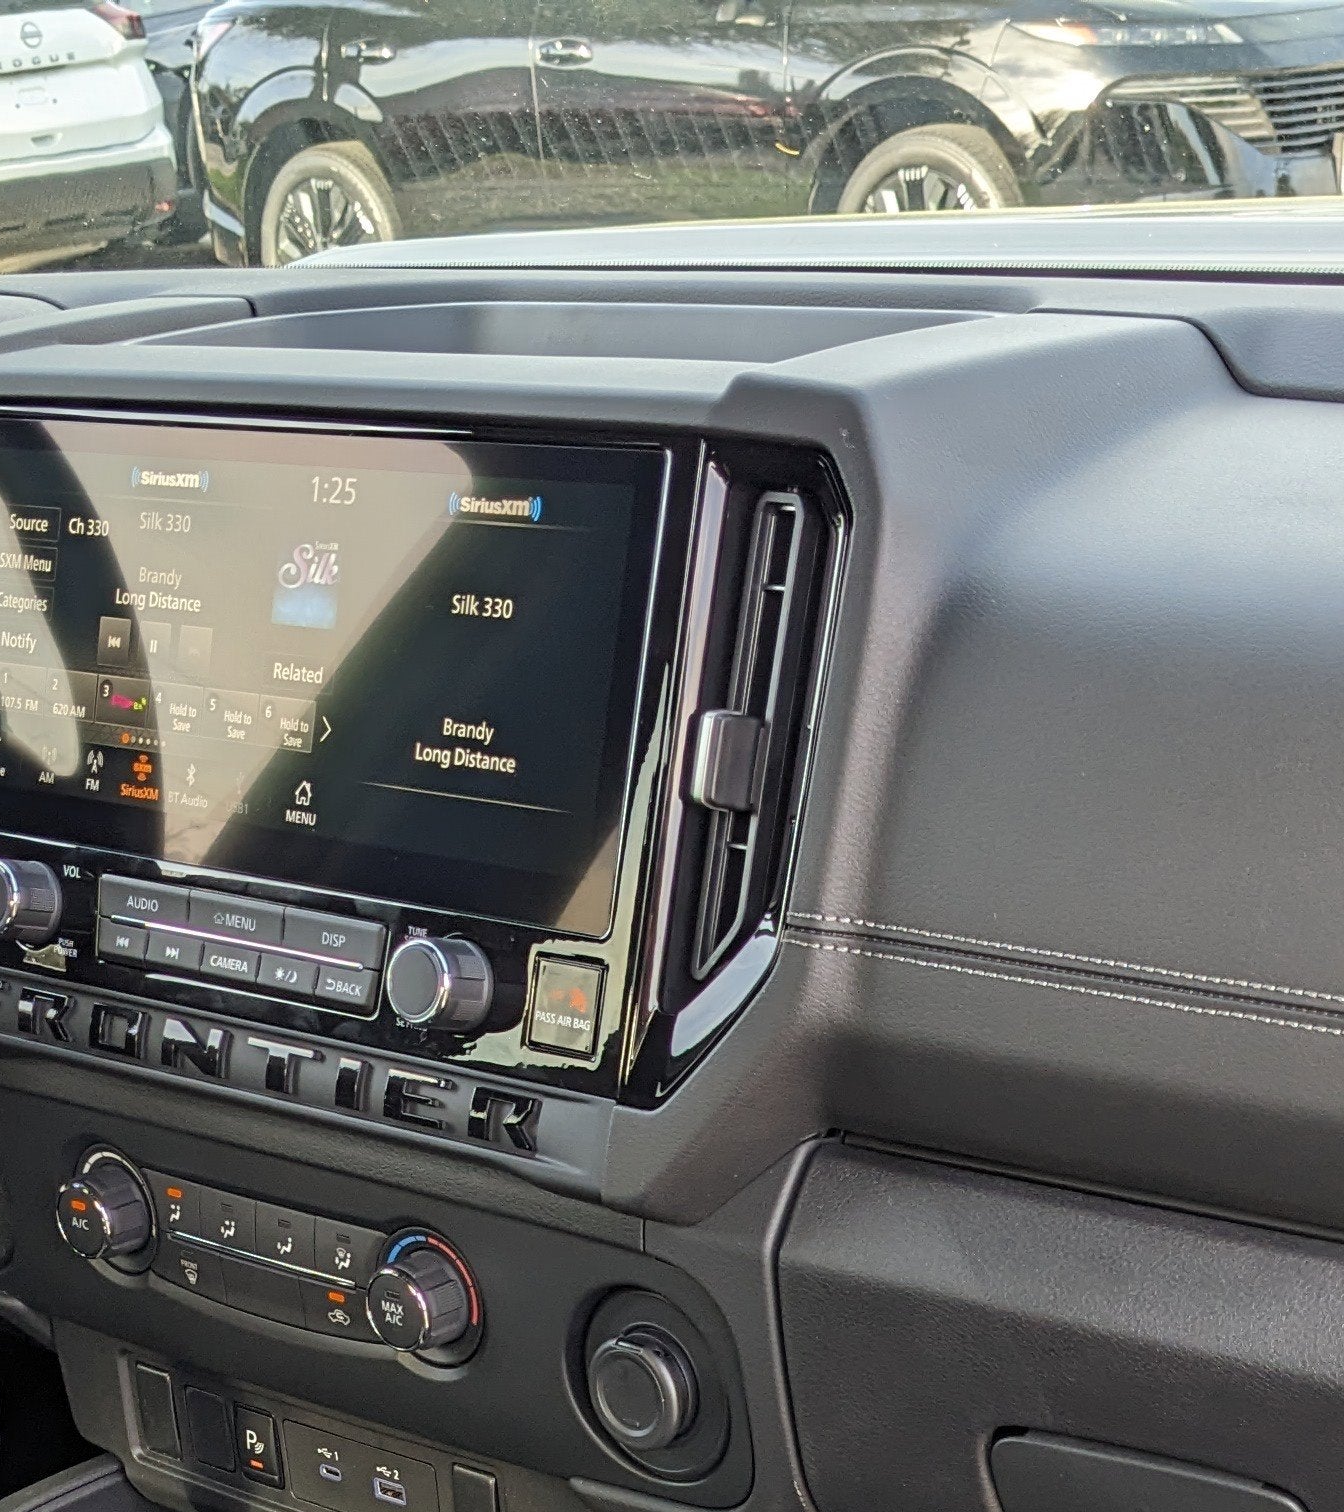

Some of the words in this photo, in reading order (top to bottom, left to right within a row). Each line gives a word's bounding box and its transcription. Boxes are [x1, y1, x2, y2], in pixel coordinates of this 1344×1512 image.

[312, 476, 357, 506] 1:25
[10, 514, 49, 532] Source
[69, 518, 85, 535] Ch
[87, 519, 109, 537] 330
[139, 512, 163, 531] Silk
[165, 514, 191, 533] 330
[0, 552, 22, 569] SXM
[24, 554, 51, 573] Menu
[278, 544, 339, 588] Silk
[139, 567, 182, 590] Brandy
[116, 589, 145, 610] Long
[149, 591, 201, 612] Distance
[451, 594, 479, 616] Silk
[482, 598, 513, 619] 330
[1, 631, 37, 654] Notify
[4, 672, 8, 683] 1
[273, 663, 323, 684] Related
[52, 679, 57, 690] 2
[103, 685, 110, 697] 3
[1, 697, 22, 709] 107.5
[25, 700, 38, 711] FM
[156, 693, 162, 703] 4
[210, 699, 216, 710] 5
[53, 703, 69, 715] 620
[70, 705, 85, 717] AM
[170, 704, 186, 717] Hold
[187, 707, 196, 717] to
[265, 706, 272, 718] 6
[173, 719, 190, 732] Save
[225, 711, 240, 724] Hold
[242, 714, 251, 725] to
[280, 718, 297, 732] Hold
[299, 722, 309, 733] to
[228, 726, 245, 739] Save
[443, 718, 494, 745] Brandy
[284, 734, 302, 748] Save
[415, 742, 450, 769] Long
[454, 748, 516, 773] Distance
[39, 772, 55, 784] AM
[86, 779, 99, 791] FM
[121, 784, 159, 800] SiriusXM
[181, 794, 208, 808] Audio
[286, 810, 316, 826] MENU
[63, 865, 81, 879] VOL
[127, 895, 159, 912] AUDIO
[225, 913, 256, 932] MENU
[322, 932, 346, 948] DISP
[210, 955, 248, 972] CAMERA
[337, 982, 363, 997] BACK
[536, 1011, 555, 1023] PASS
[557, 1015, 571, 1027] AIR
[573, 1018, 590, 1031] BAG
[71, 1217, 89, 1232] A/C
[381, 1300, 405, 1316] MAX
[385, 1312, 403, 1327] A/C
